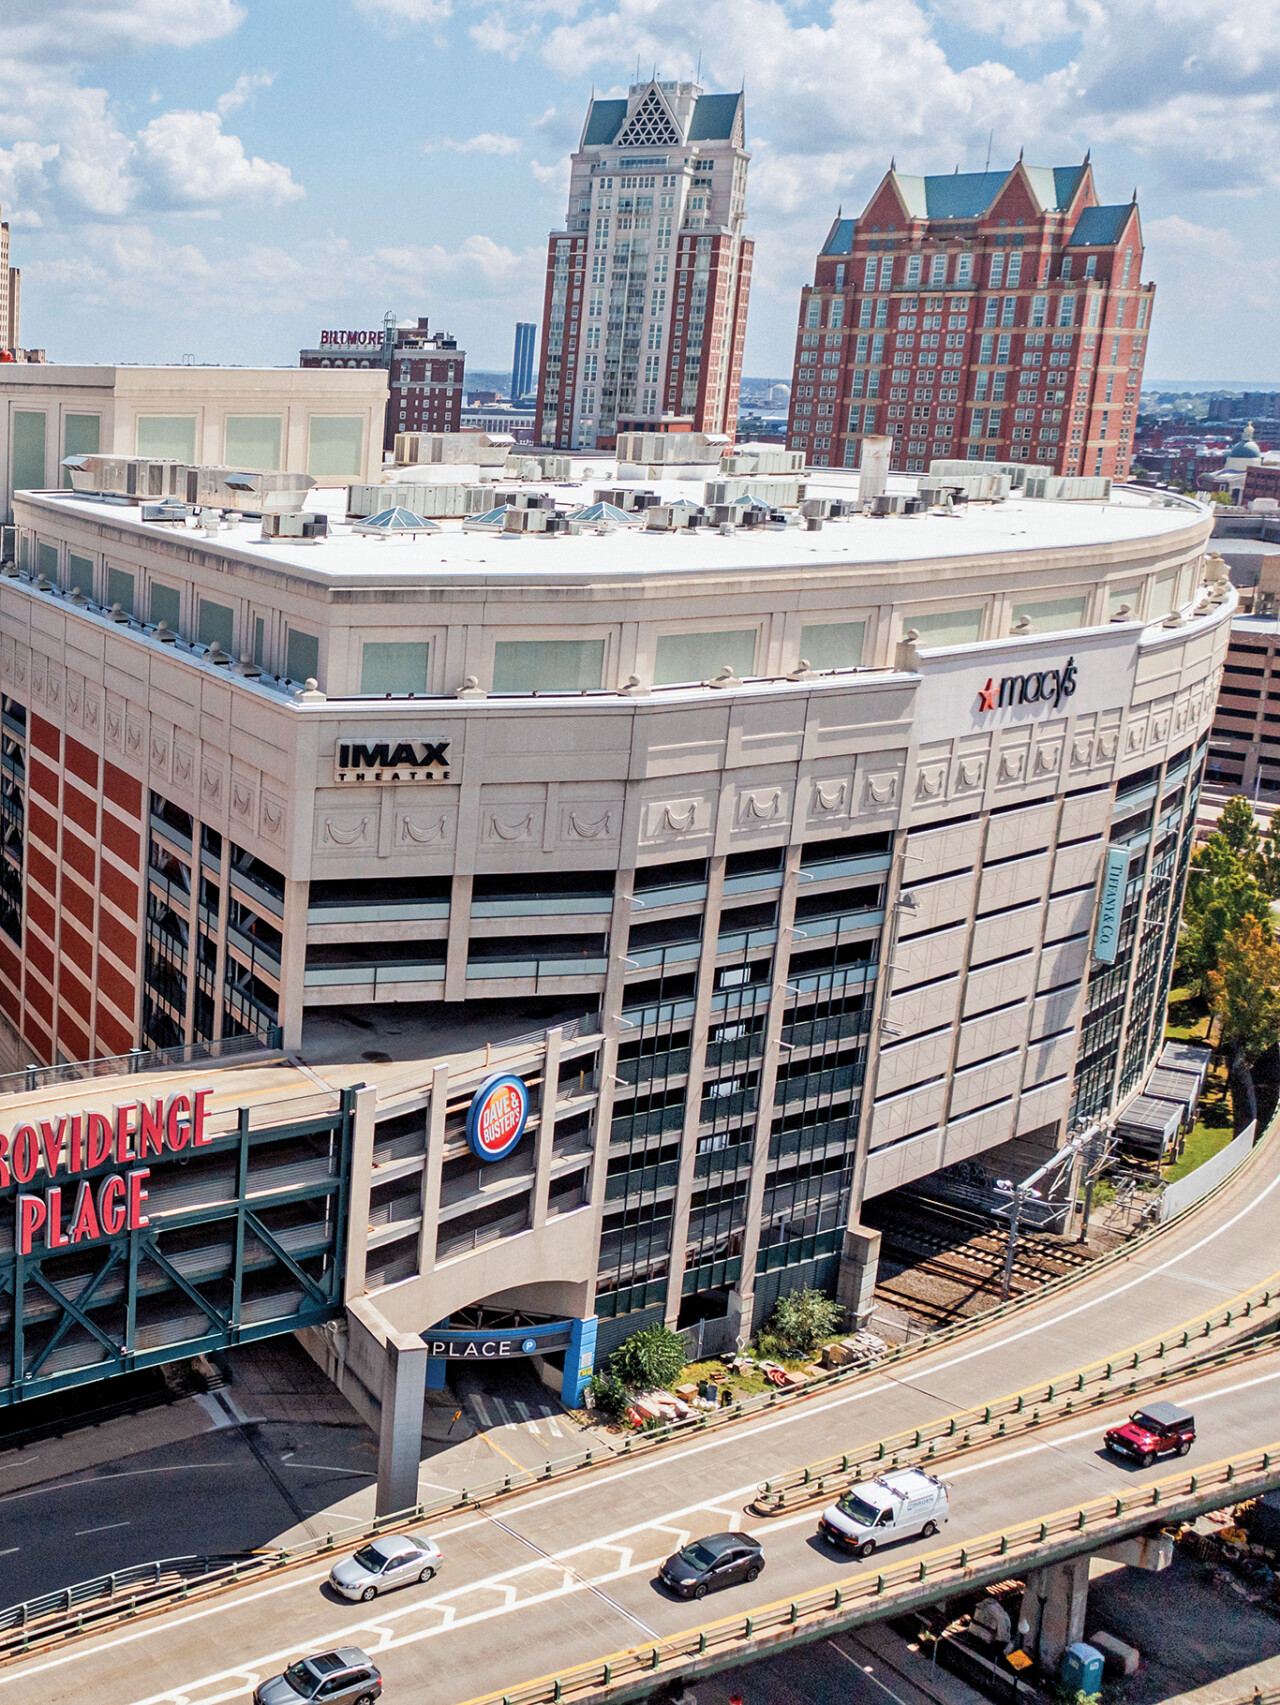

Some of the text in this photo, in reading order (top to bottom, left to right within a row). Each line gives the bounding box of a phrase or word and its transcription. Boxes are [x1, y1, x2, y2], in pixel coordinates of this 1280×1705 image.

[321, 330, 384, 345] BILTMORE
[997, 656, 1078, 708] macy's
[339, 742, 451, 768] IMAX
[338, 771, 451, 782] THEATRE
[1104, 864, 1124, 914] TIFFANY
[1102, 914, 1115, 923] &
[483, 1091, 520, 1129] DAVE &
[483, 1107, 520, 1144] BUSTER'S
[15, 1167, 151, 1255] PLACE
[432, 1341, 512, 1357] PLACE
